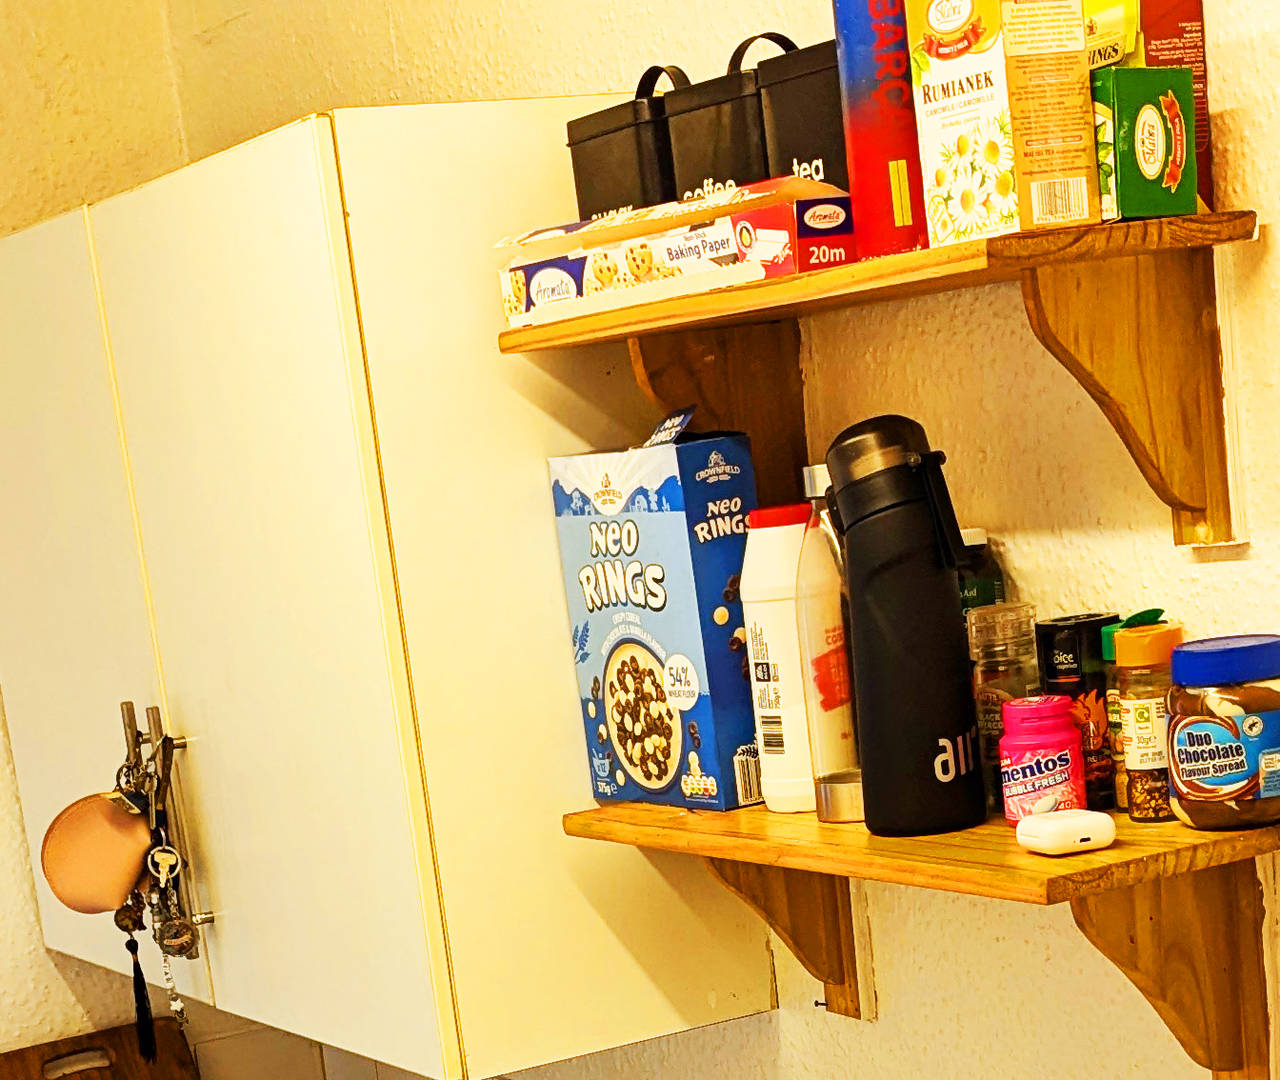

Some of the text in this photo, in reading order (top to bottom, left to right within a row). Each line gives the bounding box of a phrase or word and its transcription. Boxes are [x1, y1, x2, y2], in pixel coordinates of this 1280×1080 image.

[921, 70, 994, 104] RUMIANEK
[792, 158, 824, 181] tea
[666, 238, 730, 261] Baking Paper
[809, 245, 846, 264] 20m
[695, 466, 740, 481] CROWNFIELD
[578, 559, 667, 613] RINGS
[669, 666, 691, 687] 54%
[1187, 731, 1213, 747] Duo
[1177, 743, 1244, 765] Chocolate
[1181, 760, 1246, 778] Flavour Spread
[1035, 771, 1069, 789] FRESH
